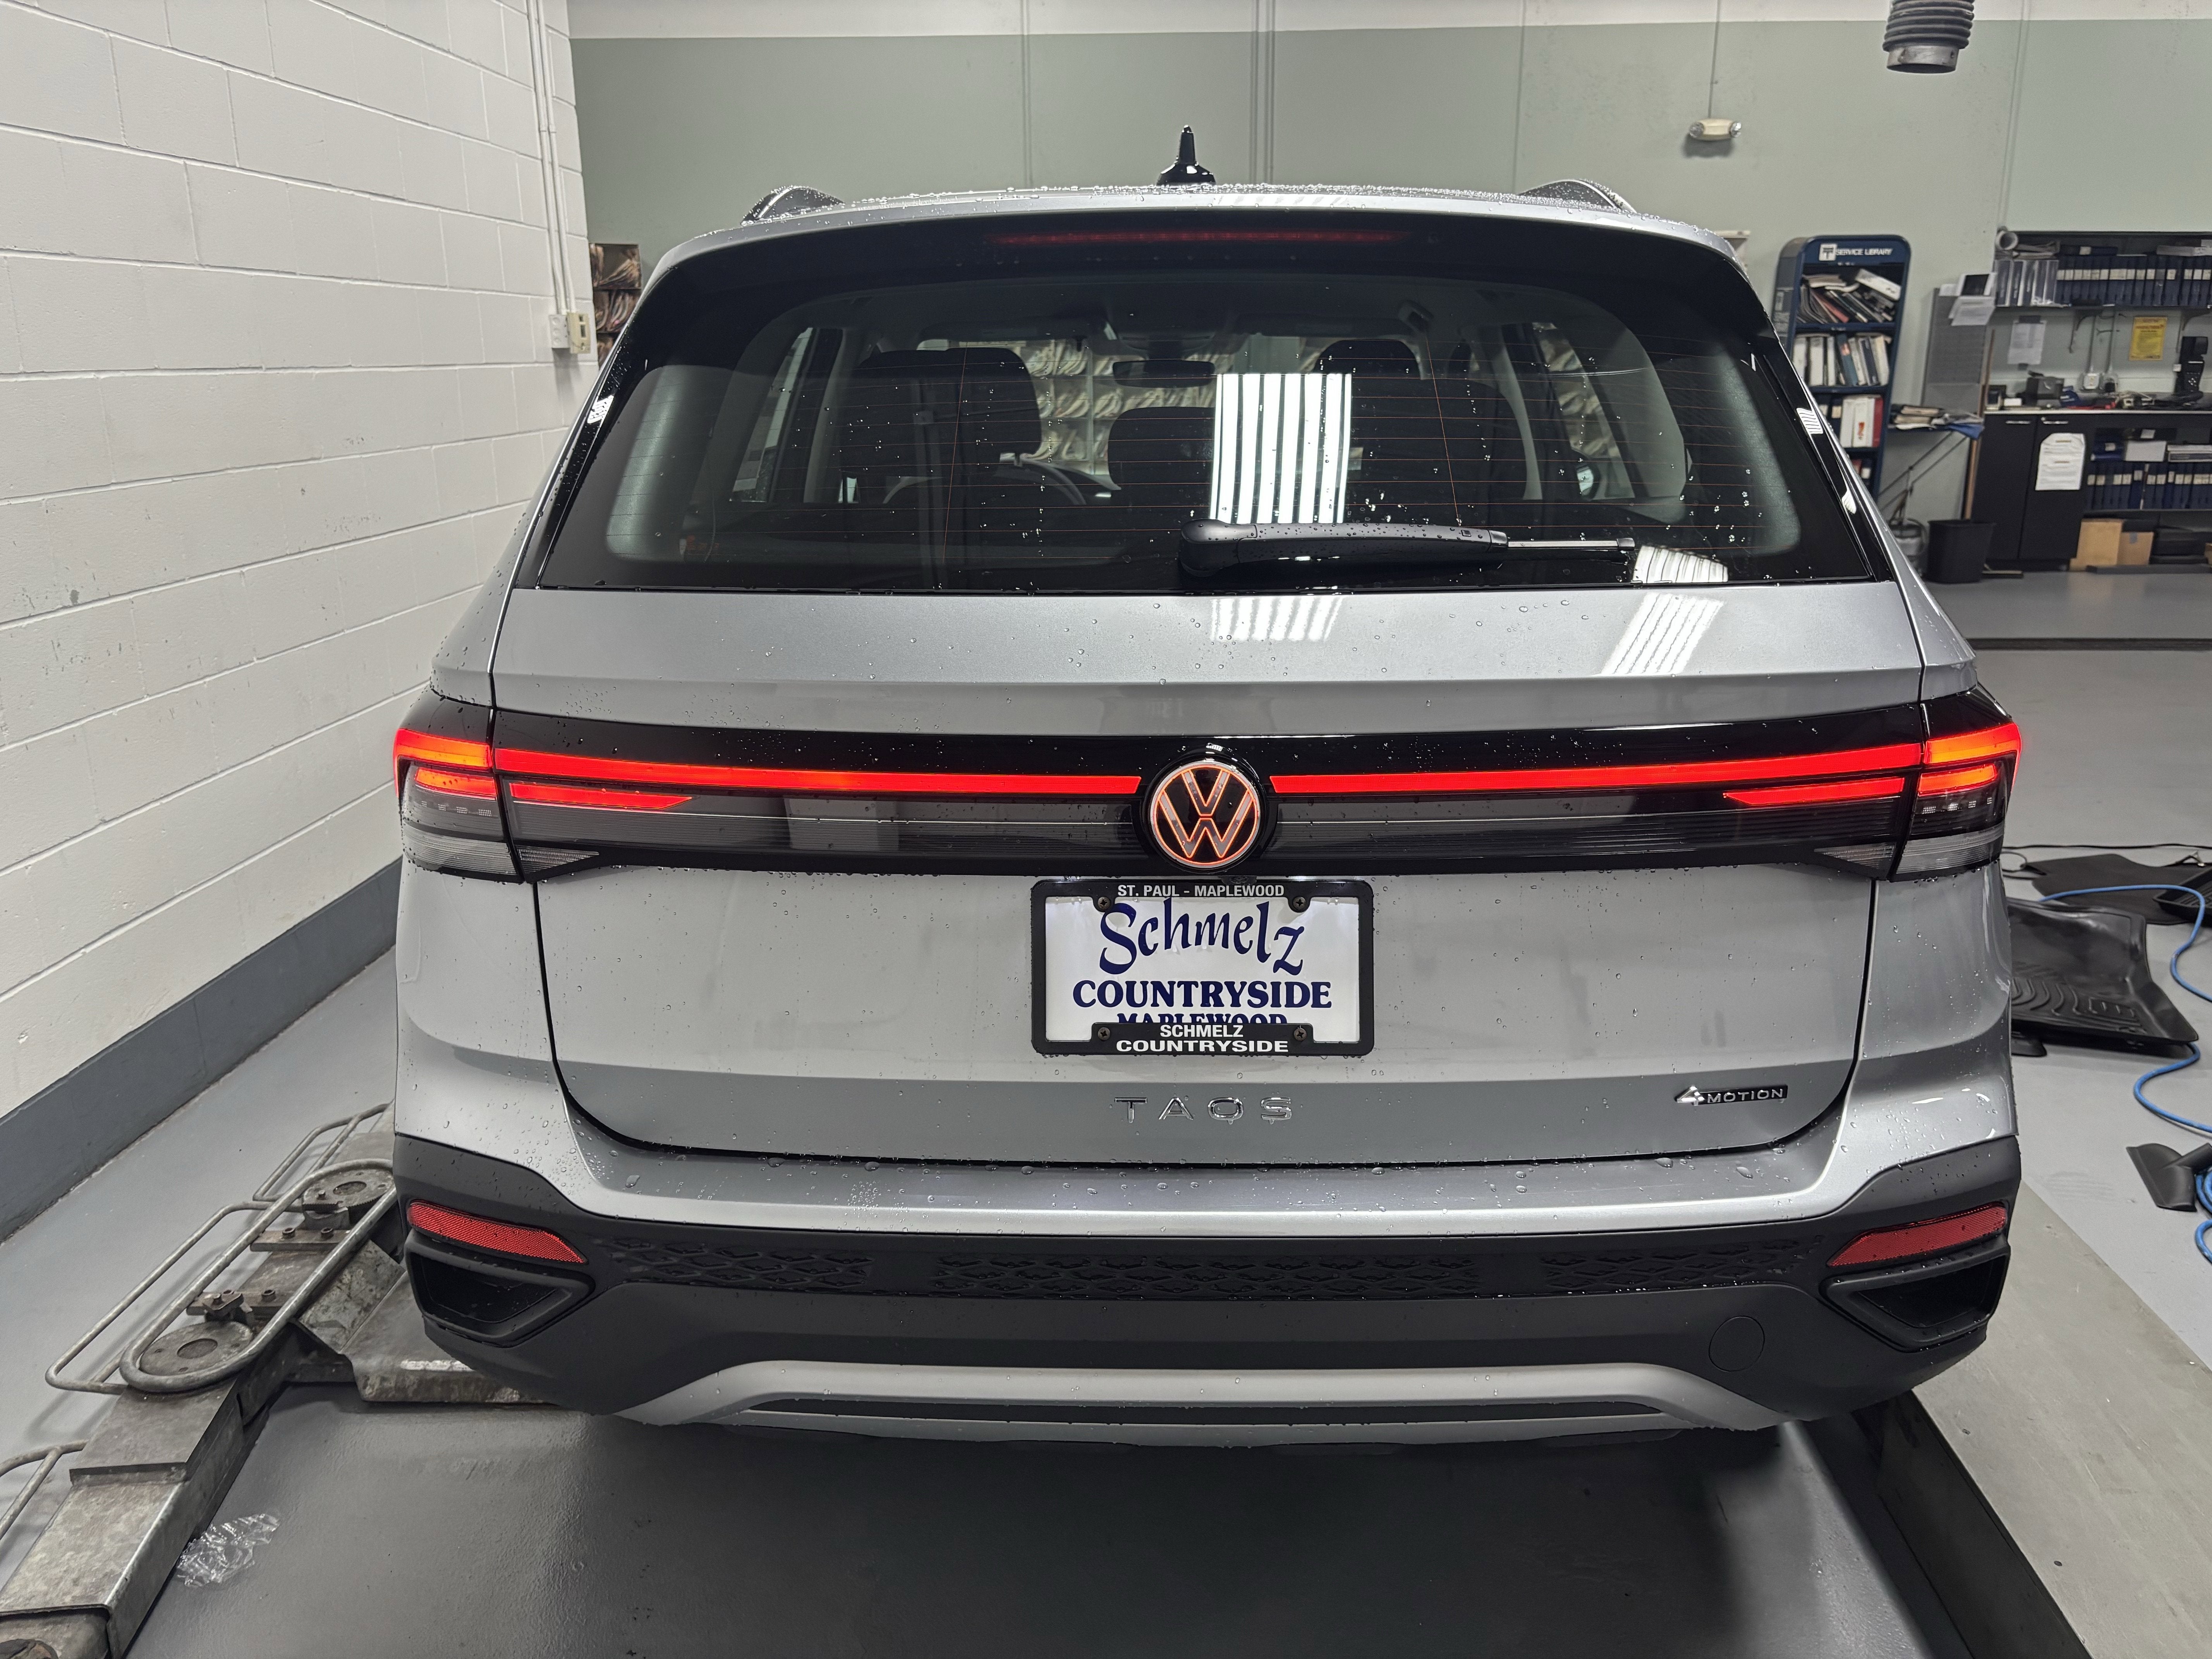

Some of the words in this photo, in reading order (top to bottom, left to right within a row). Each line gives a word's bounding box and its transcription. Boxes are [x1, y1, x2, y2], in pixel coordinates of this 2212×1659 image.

[1118, 885, 1139, 896] ST.
[1144, 885, 1180, 896] PAUL
[1194, 885, 1284, 896] MAPLEWOOD
[1099, 897, 1305, 975] Schmelz
[1073, 980, 1332, 1008] COUNTRYSIDE
[1160, 1024, 1243, 1037] SCHMELZ
[1116, 1040, 1289, 1053] COUNTRYSIDE
[1676, 1085, 1784, 1105] 4MOTION
[1115, 1097, 1292, 1121] TAOS
